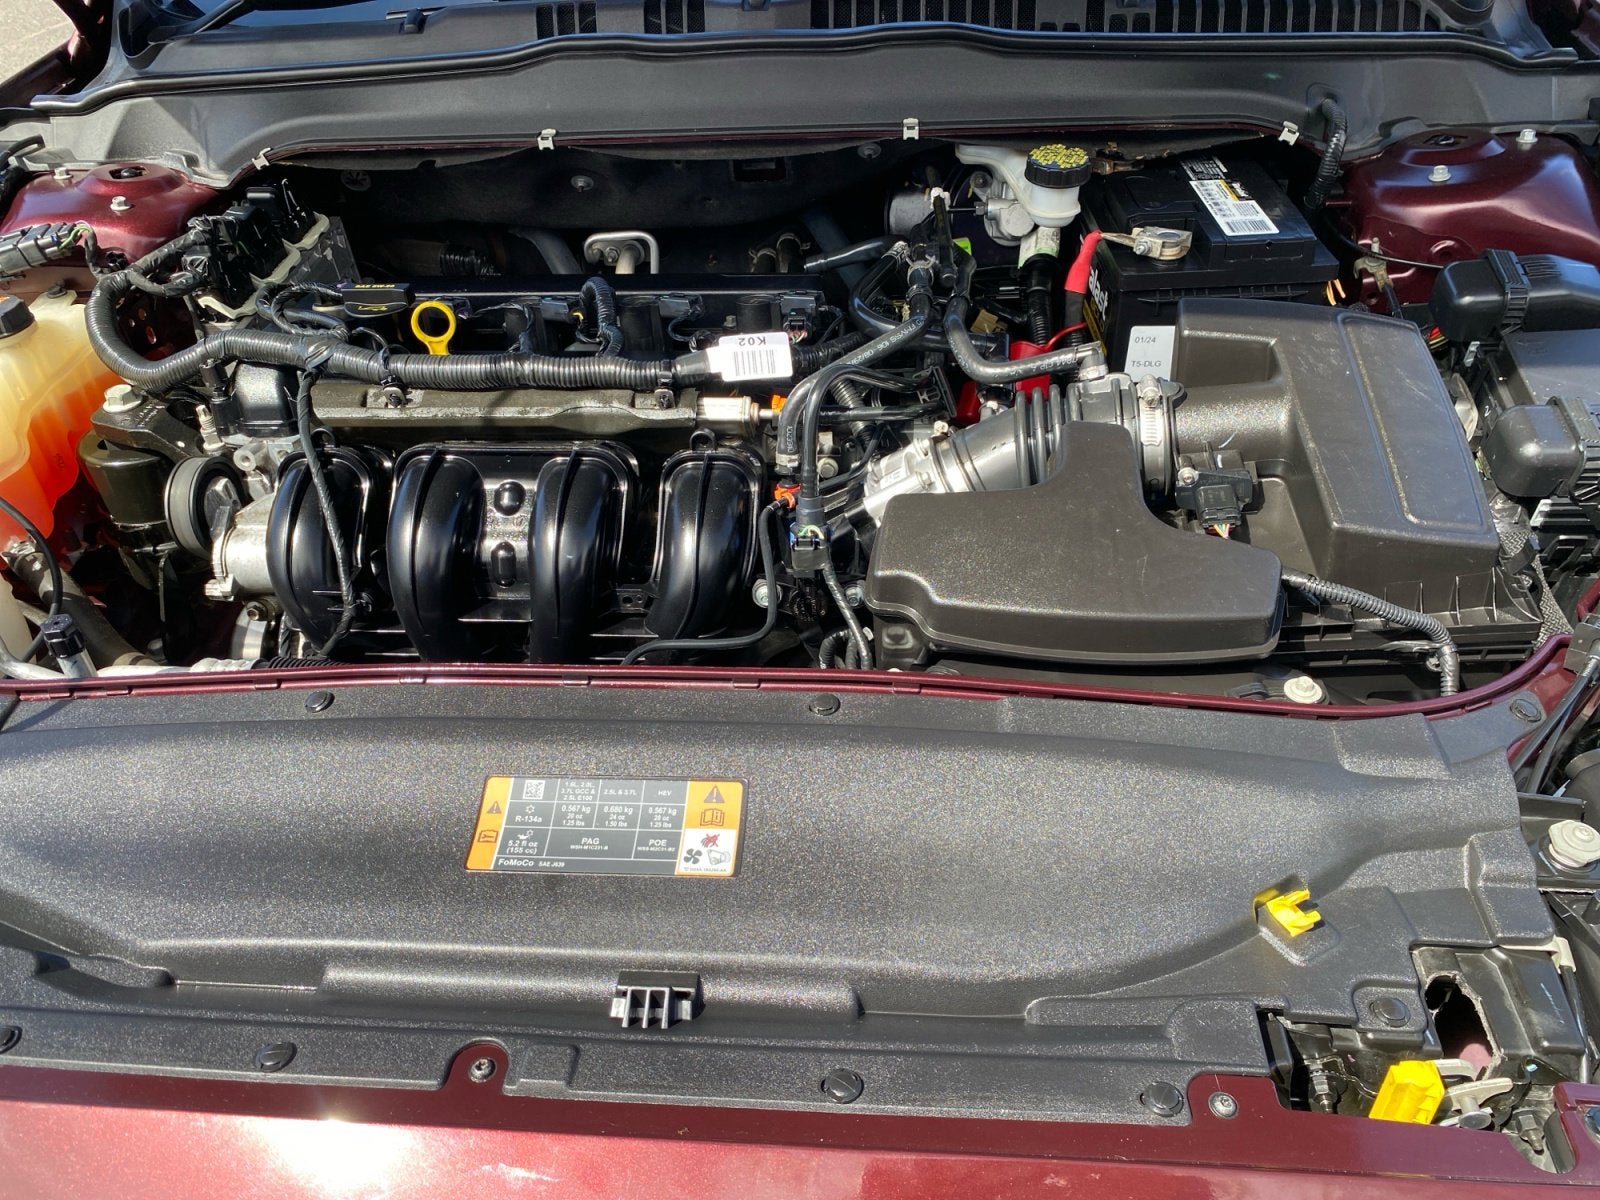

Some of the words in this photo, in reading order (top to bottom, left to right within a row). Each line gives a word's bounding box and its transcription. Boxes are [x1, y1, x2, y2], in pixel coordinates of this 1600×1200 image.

[1088, 266, 1109, 322] alast
[738, 336, 766, 346] K02
[624, 807, 634, 815] kg
[498, 858, 534, 866] FoMoCo
